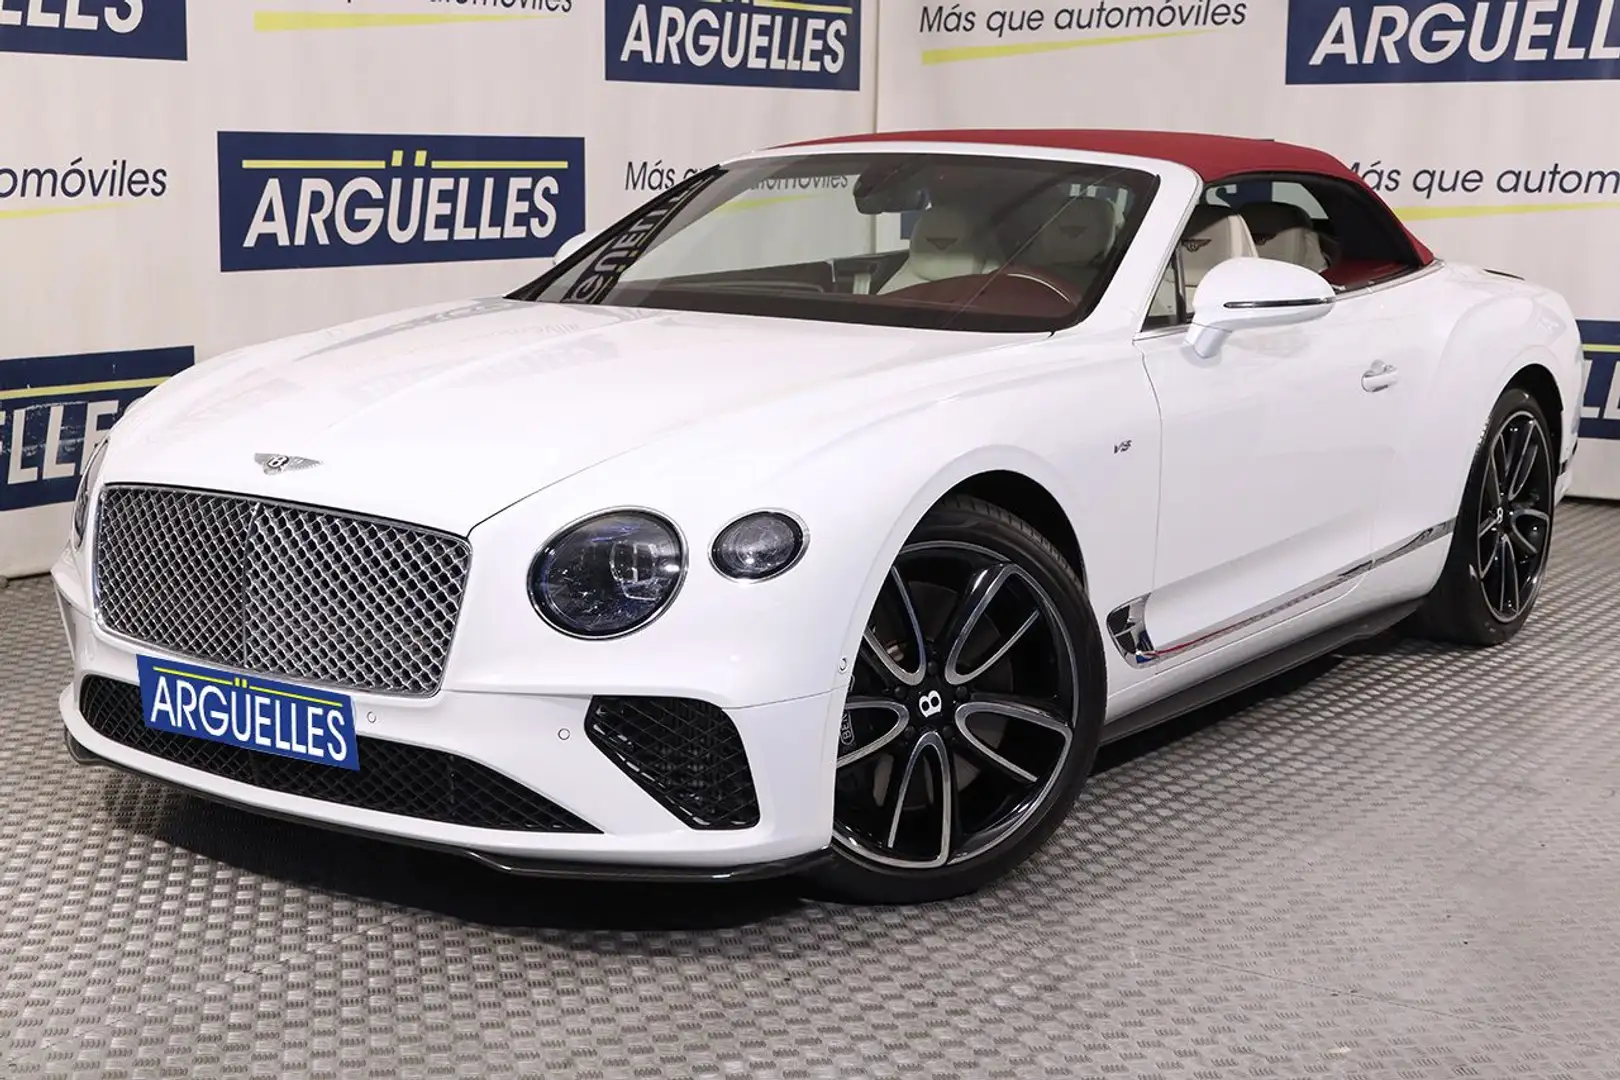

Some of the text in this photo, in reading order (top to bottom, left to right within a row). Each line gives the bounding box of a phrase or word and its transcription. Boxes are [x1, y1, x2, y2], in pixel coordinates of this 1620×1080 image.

[919, 0, 1246, 37] Más que automóviles
[625, 160, 676, 190] Más
[1412, 169, 1484, 199] que
[242, 149, 559, 247] ARGÜELLES
[150, 675, 347, 762] ARGÜELLES
